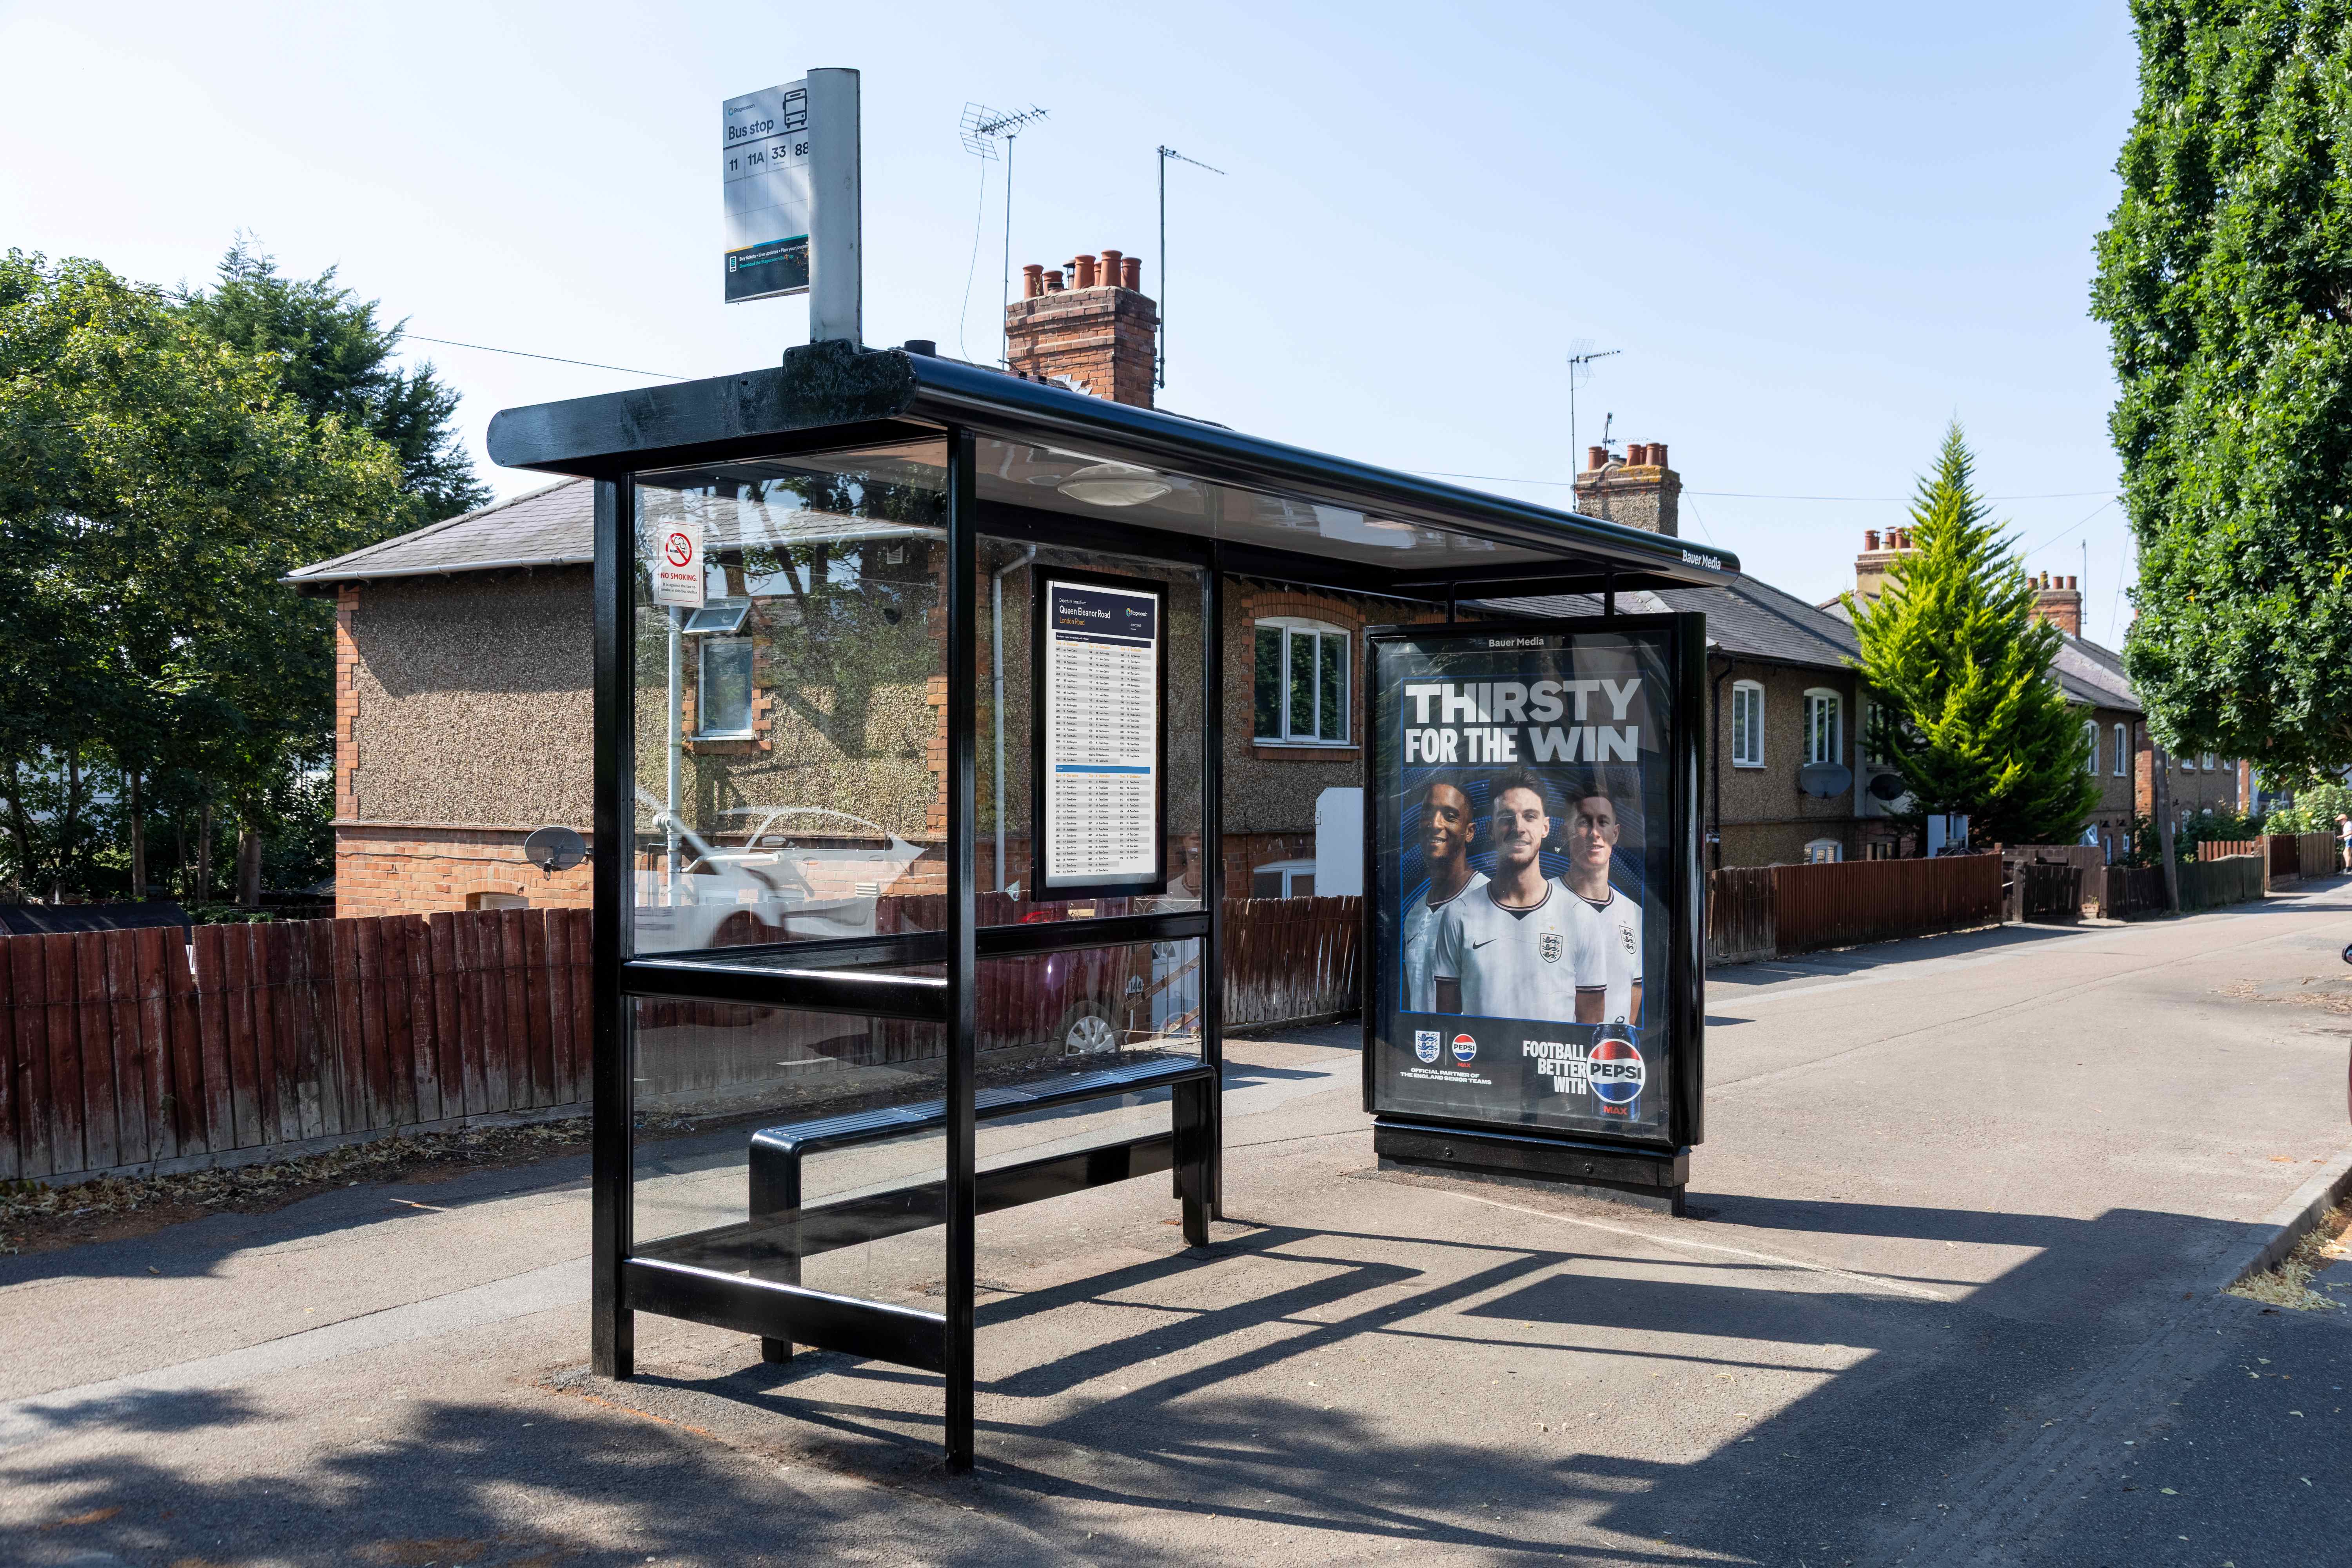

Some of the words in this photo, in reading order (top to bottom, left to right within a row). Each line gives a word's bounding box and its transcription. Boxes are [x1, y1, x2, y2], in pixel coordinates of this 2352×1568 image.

[734, 103, 755, 113] Stagecoach
[729, 126, 747, 140] Bus
[750, 120, 774, 134] stop
[730, 158, 737, 171] 11
[748, 152, 764, 165] 11A
[772, 145, 786, 160] 33
[795, 142, 808, 156] 88
[1682, 549, 1702, 565] Bauer
[1702, 554, 1721, 570] Media
[1060, 606, 1077, 615] Queen
[1078, 608, 1097, 617] Eleanor
[1098, 610, 1110, 619] Road
[1489, 639, 1515, 647] Bauer
[1517, 637, 1544, 646] Media
[1405, 679, 1642, 723] THIRSTY
[1406, 728, 1458, 763] FOR
[1464, 728, 1518, 762] THE
[1529, 726, 1639, 762] WIN
[1131, 981, 1142, 991] 144
[1523, 1040, 1587, 1061] FOOTBALL
[1538, 1058, 1586, 1078] BETTER
[1590, 1063, 1641, 1080] PEPSI
[1554, 1076, 1586, 1094] WITH
[1603, 1106, 1627, 1115] MAX
